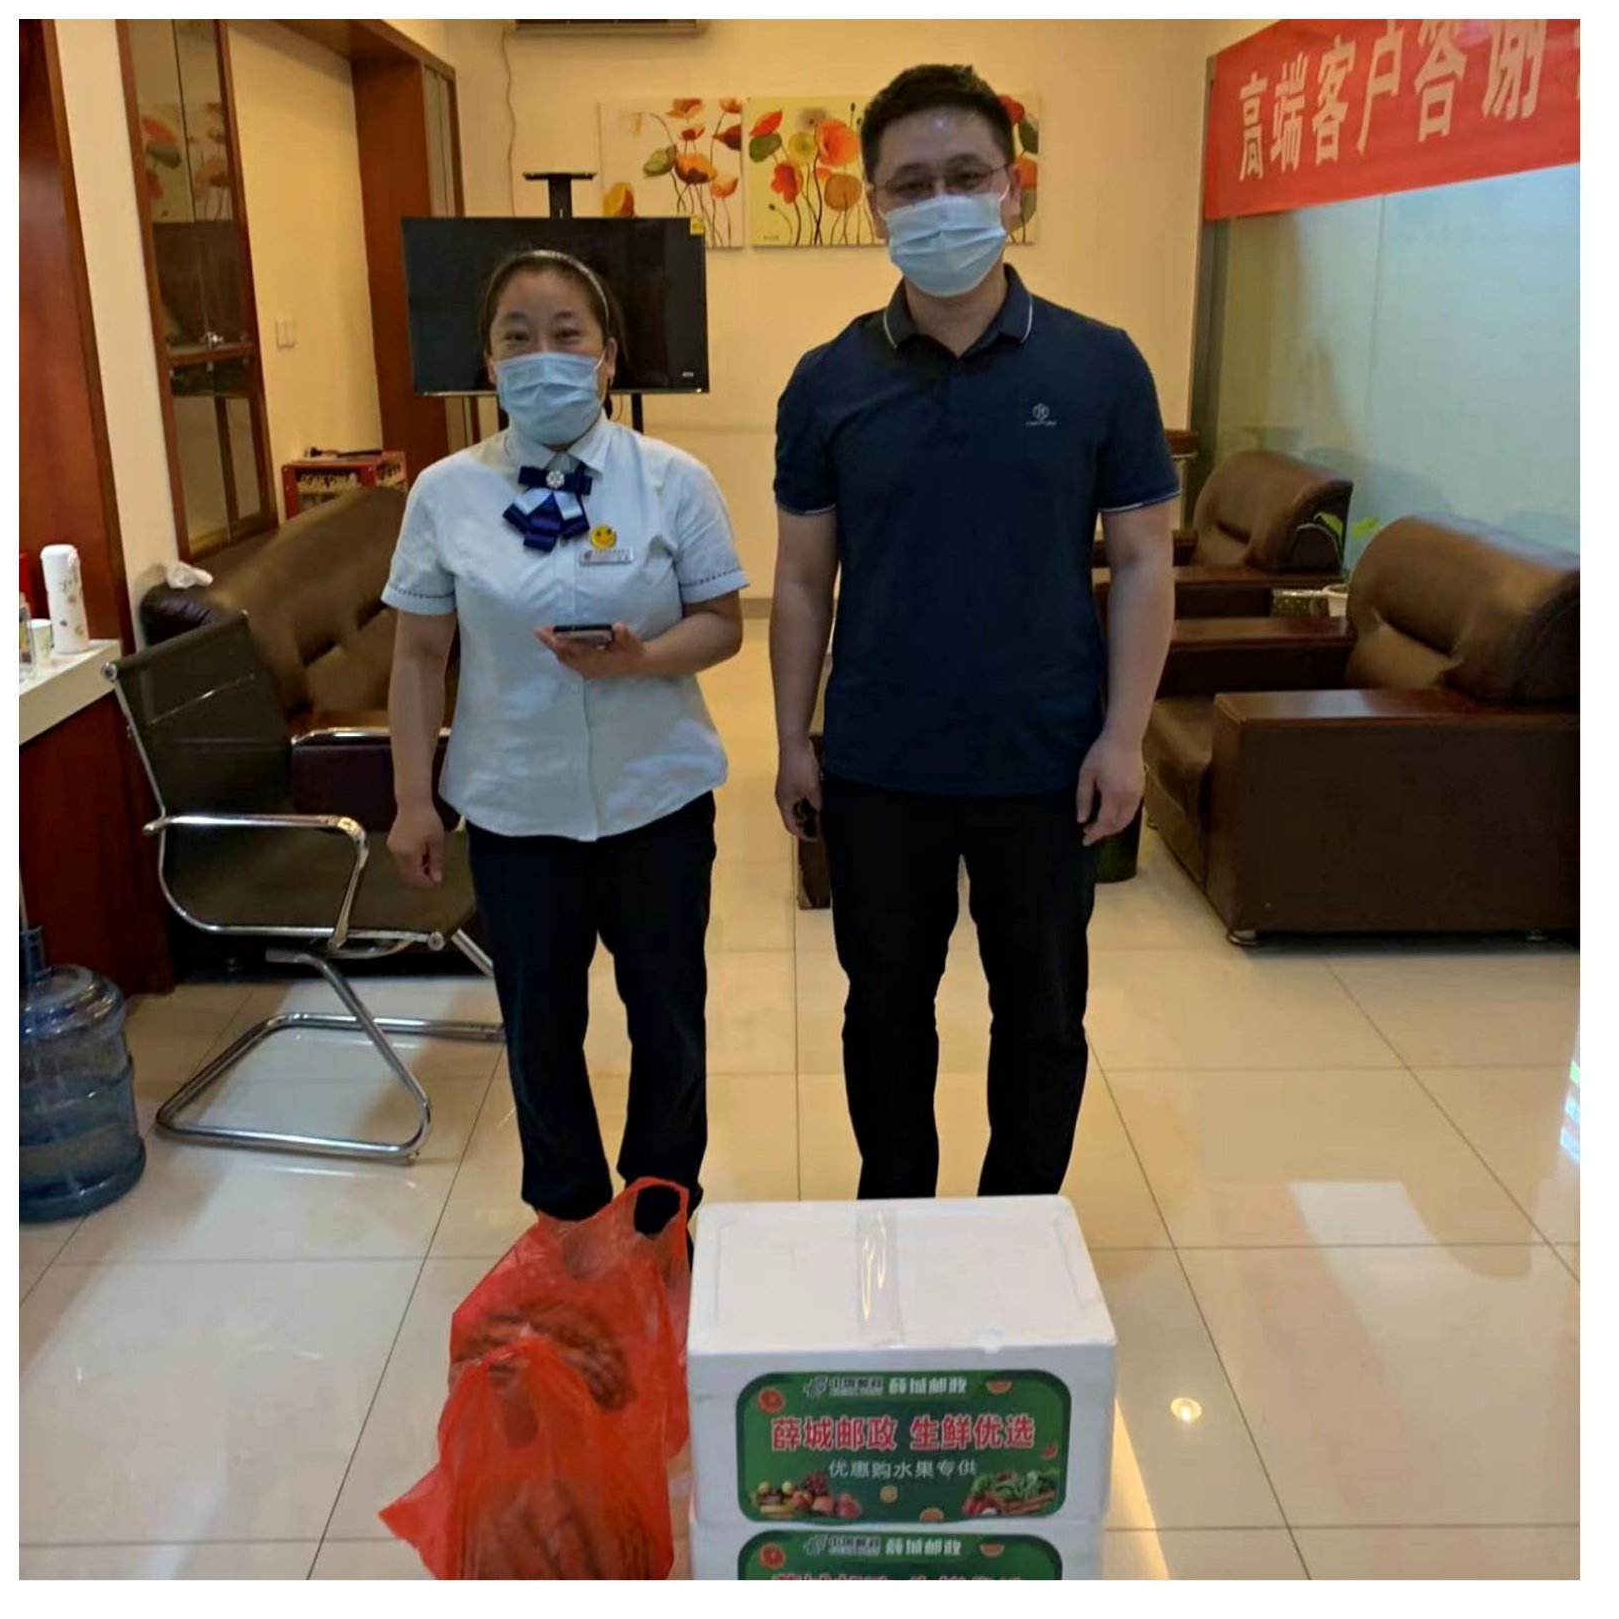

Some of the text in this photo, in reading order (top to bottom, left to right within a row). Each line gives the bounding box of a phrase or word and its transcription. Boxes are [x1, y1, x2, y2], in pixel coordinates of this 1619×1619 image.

[1239, 19, 1580, 182] 高端客户答谢
[770, 1413, 1036, 1452] 薛城邮政 生鲜优选
[828, 1458, 978, 1479] 优惠购水果专供
